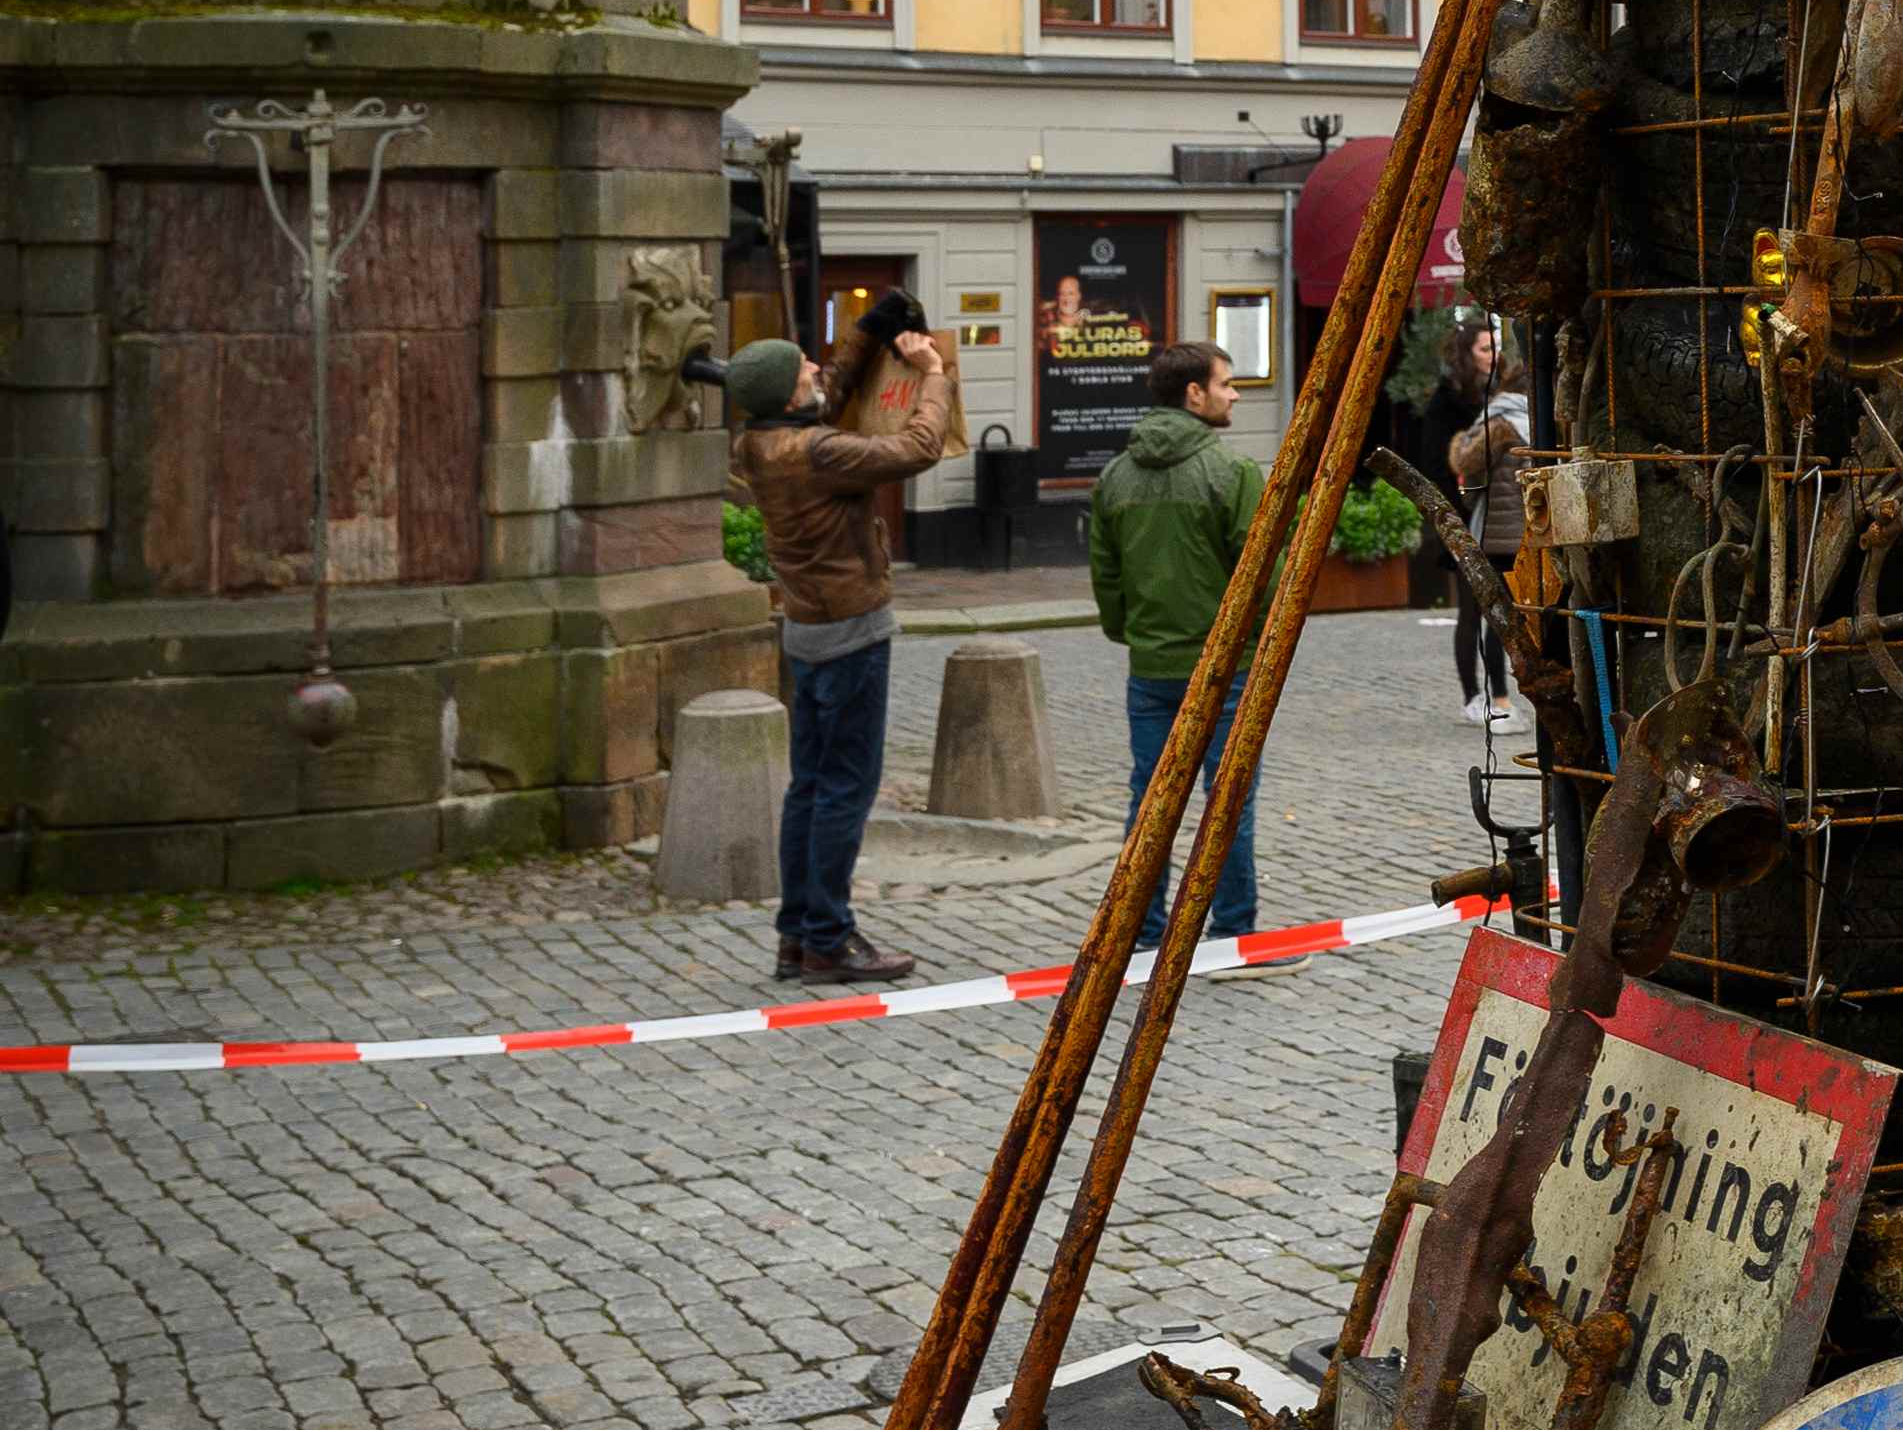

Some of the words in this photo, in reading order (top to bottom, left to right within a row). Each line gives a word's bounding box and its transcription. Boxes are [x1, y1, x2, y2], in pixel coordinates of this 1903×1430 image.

[1056, 325, 1143, 341] PLURAS
[1052, 341, 1153, 358] JULBORD
[1459, 1035, 1800, 1283] Ftöjning
